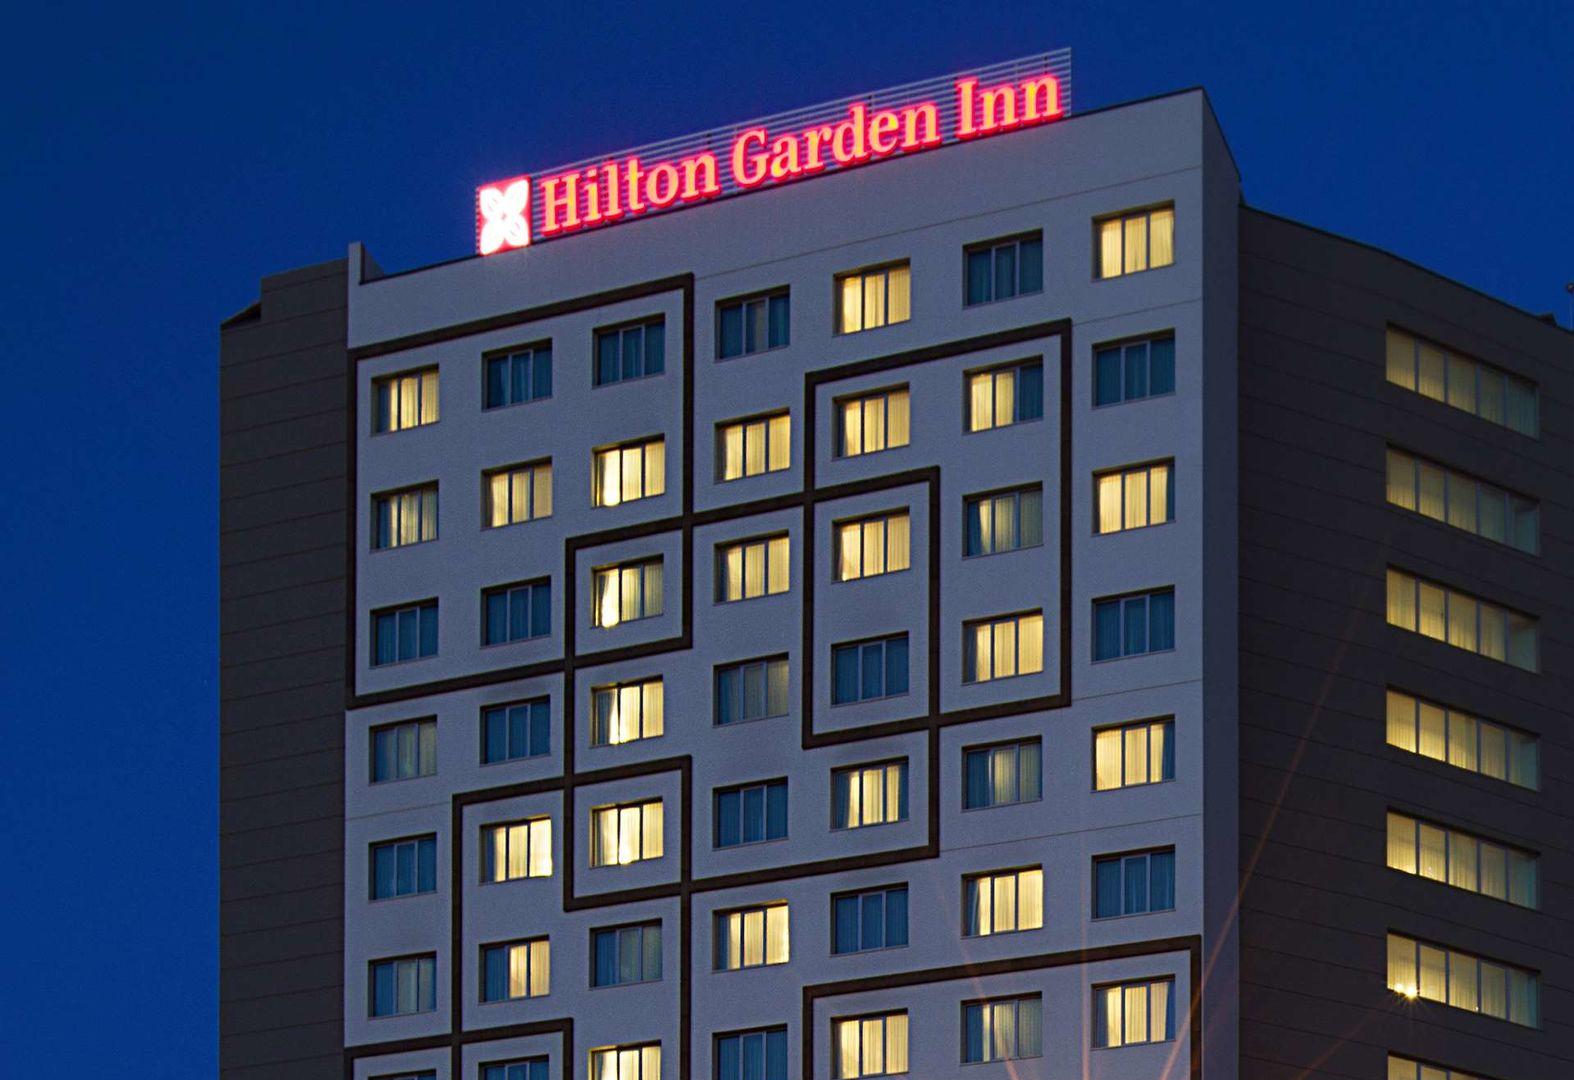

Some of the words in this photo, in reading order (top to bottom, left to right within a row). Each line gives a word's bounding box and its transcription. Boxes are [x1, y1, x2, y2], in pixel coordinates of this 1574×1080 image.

[539, 155, 720, 236] Hilton
[731, 100, 942, 188] Garden
[954, 73, 1063, 138] Inn
